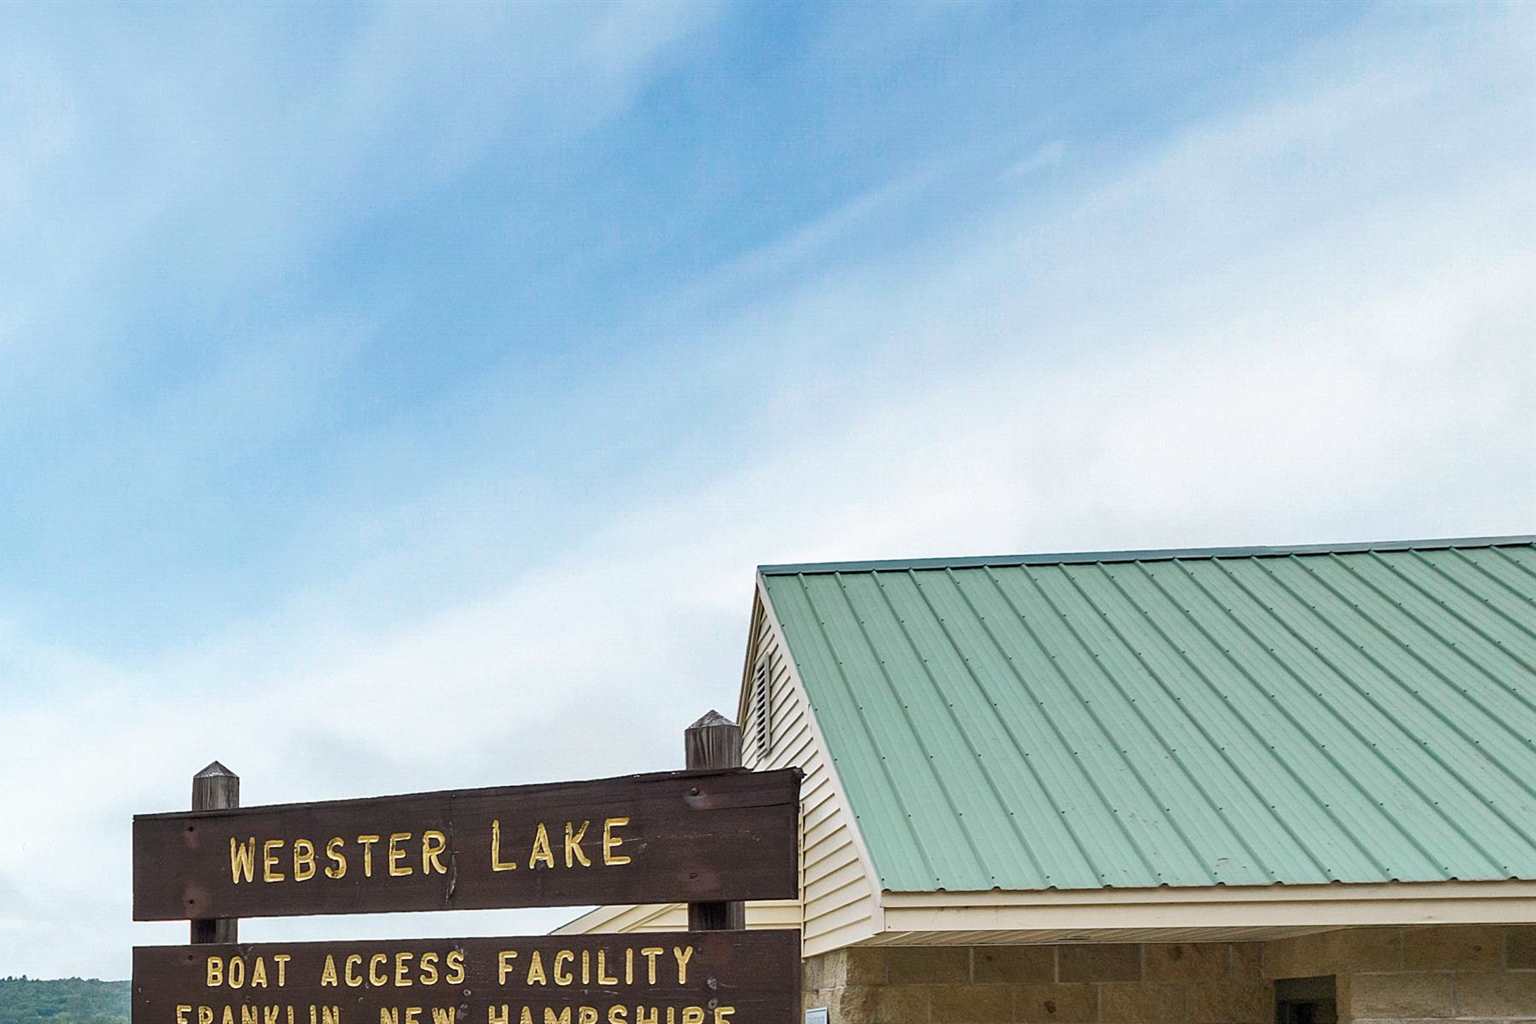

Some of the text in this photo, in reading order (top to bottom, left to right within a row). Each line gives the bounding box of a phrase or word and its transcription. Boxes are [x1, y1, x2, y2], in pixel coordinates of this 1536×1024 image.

[230, 816, 632, 884] WEBSTER LAKE
[207, 945, 694, 988] BOAT ACCESS FACILITY
